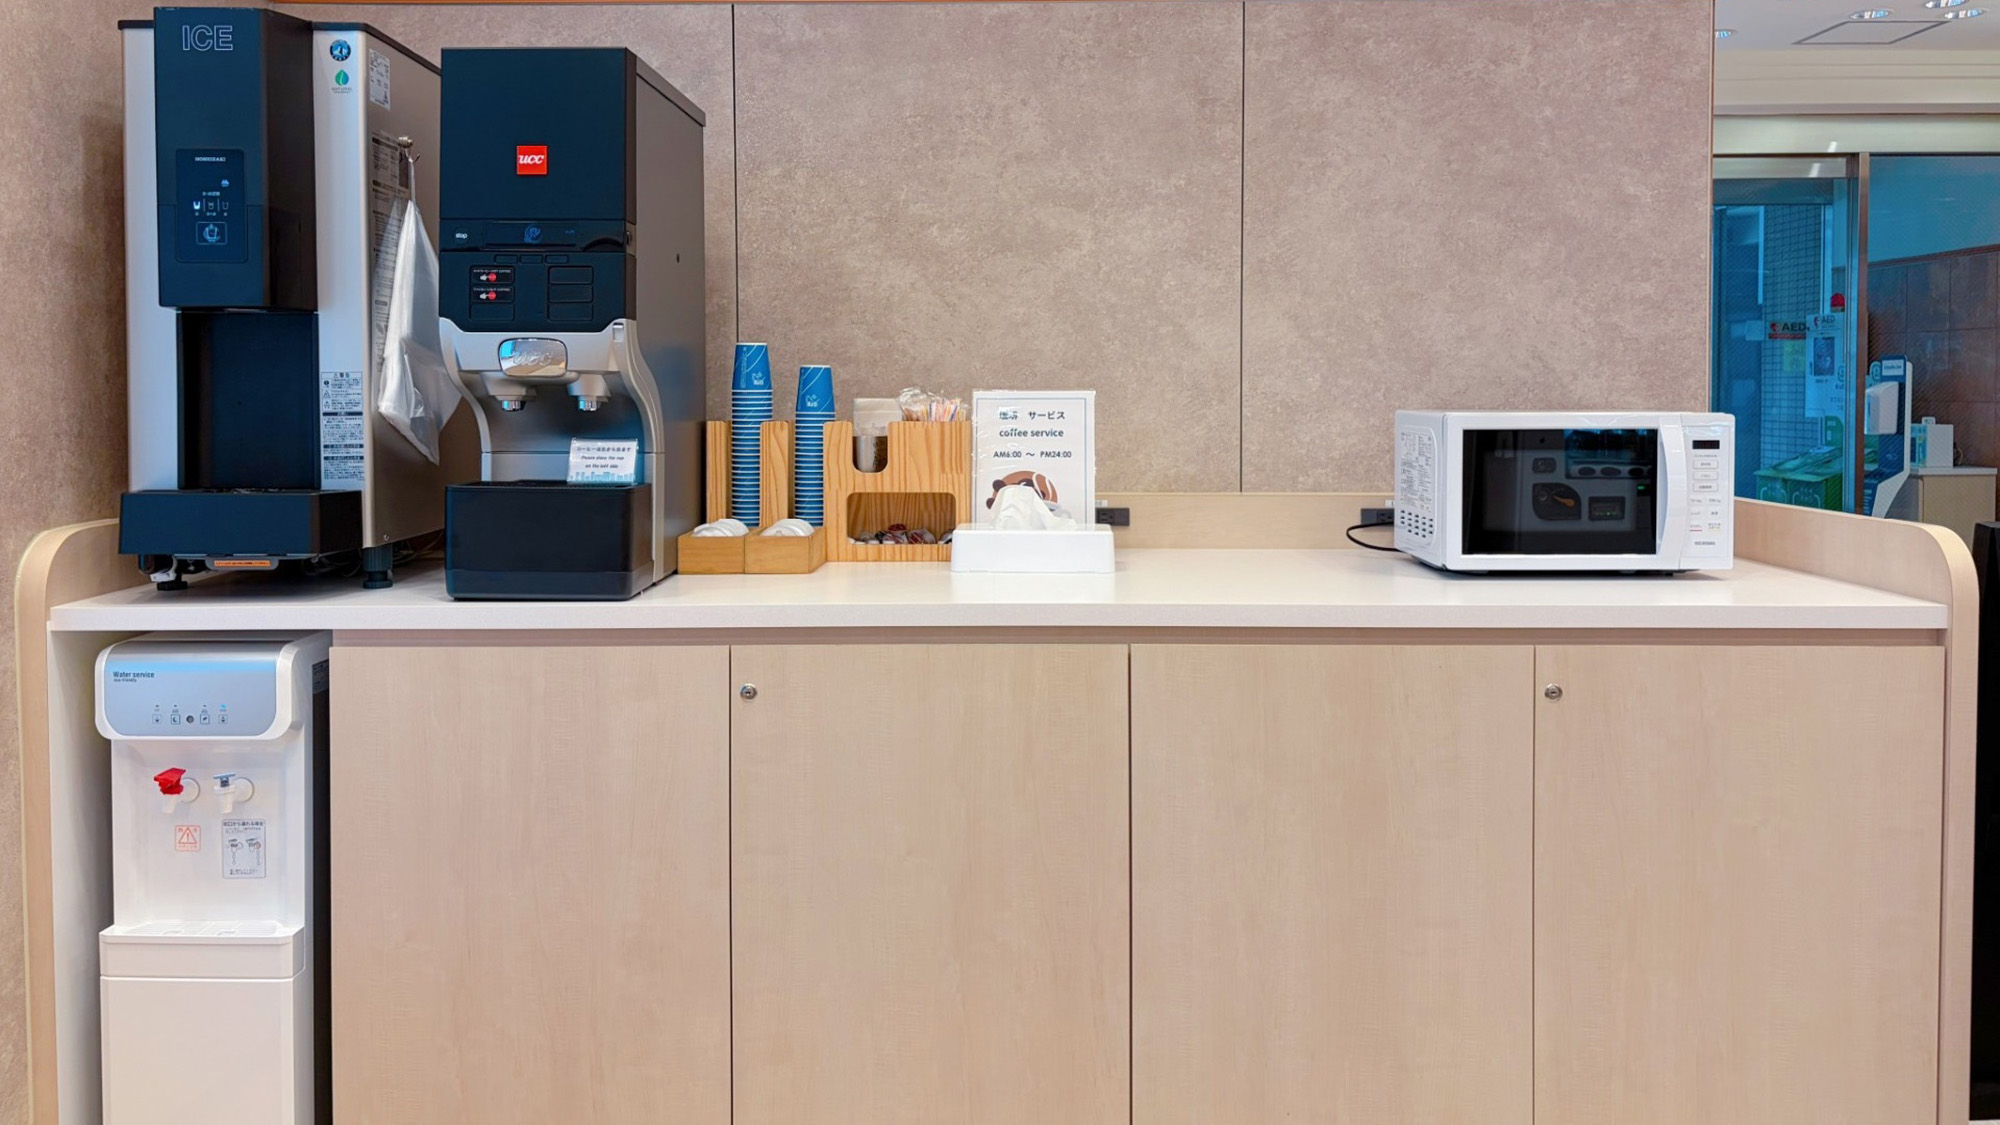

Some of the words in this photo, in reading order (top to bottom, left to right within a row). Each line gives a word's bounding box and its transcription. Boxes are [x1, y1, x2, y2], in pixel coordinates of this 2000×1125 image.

[181, 24, 233, 51] ICE
[1822, 315, 1836, 323] AED
[1028, 411, 1066, 420] サービス
[999, 428, 1028, 437] coffee
[1030, 428, 1064, 437] service
[993, 450, 1022, 458] AM6:00
[1040, 450, 1072, 458] PM24:00
